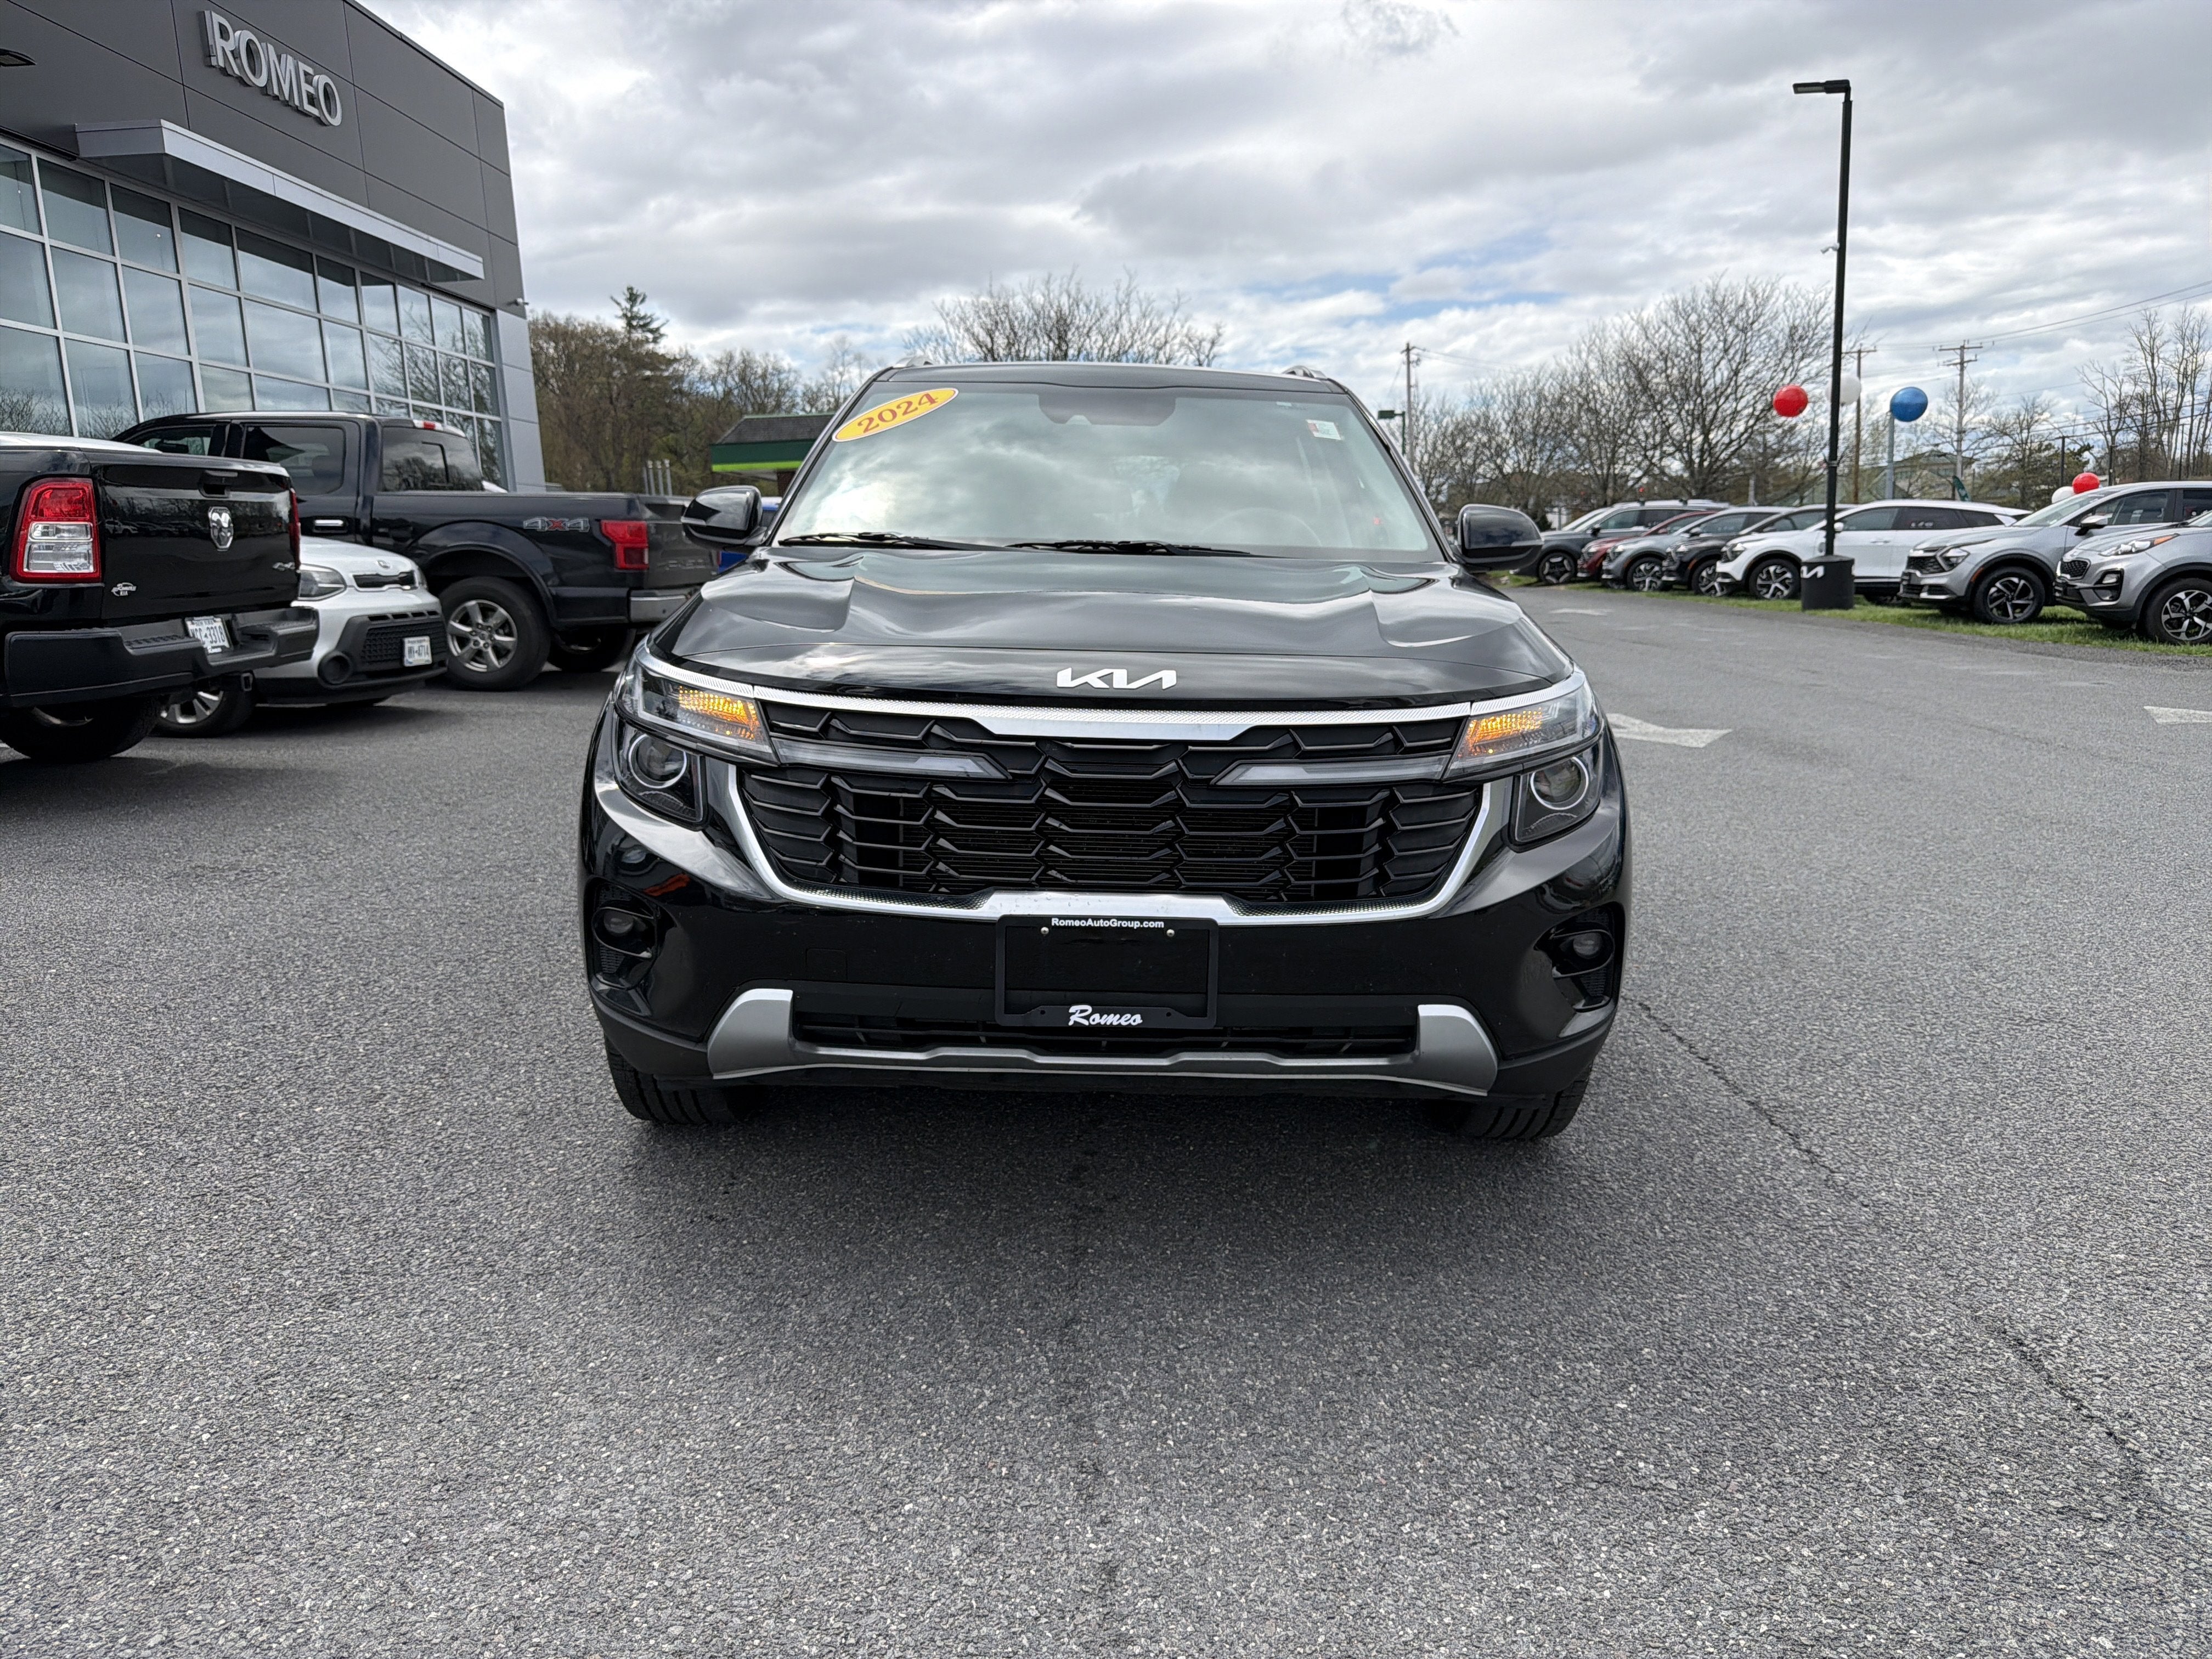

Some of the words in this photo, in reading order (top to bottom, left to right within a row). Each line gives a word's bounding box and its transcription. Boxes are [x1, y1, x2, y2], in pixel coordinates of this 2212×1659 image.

[202, 10, 342, 127] ROMEO
[857, 393, 939, 434] 2024
[1057, 667, 1177, 690] KIA
[1051, 917, 1165, 929] RomeoAutoGroup.com
[1068, 1005, 1143, 1027] Romeo
